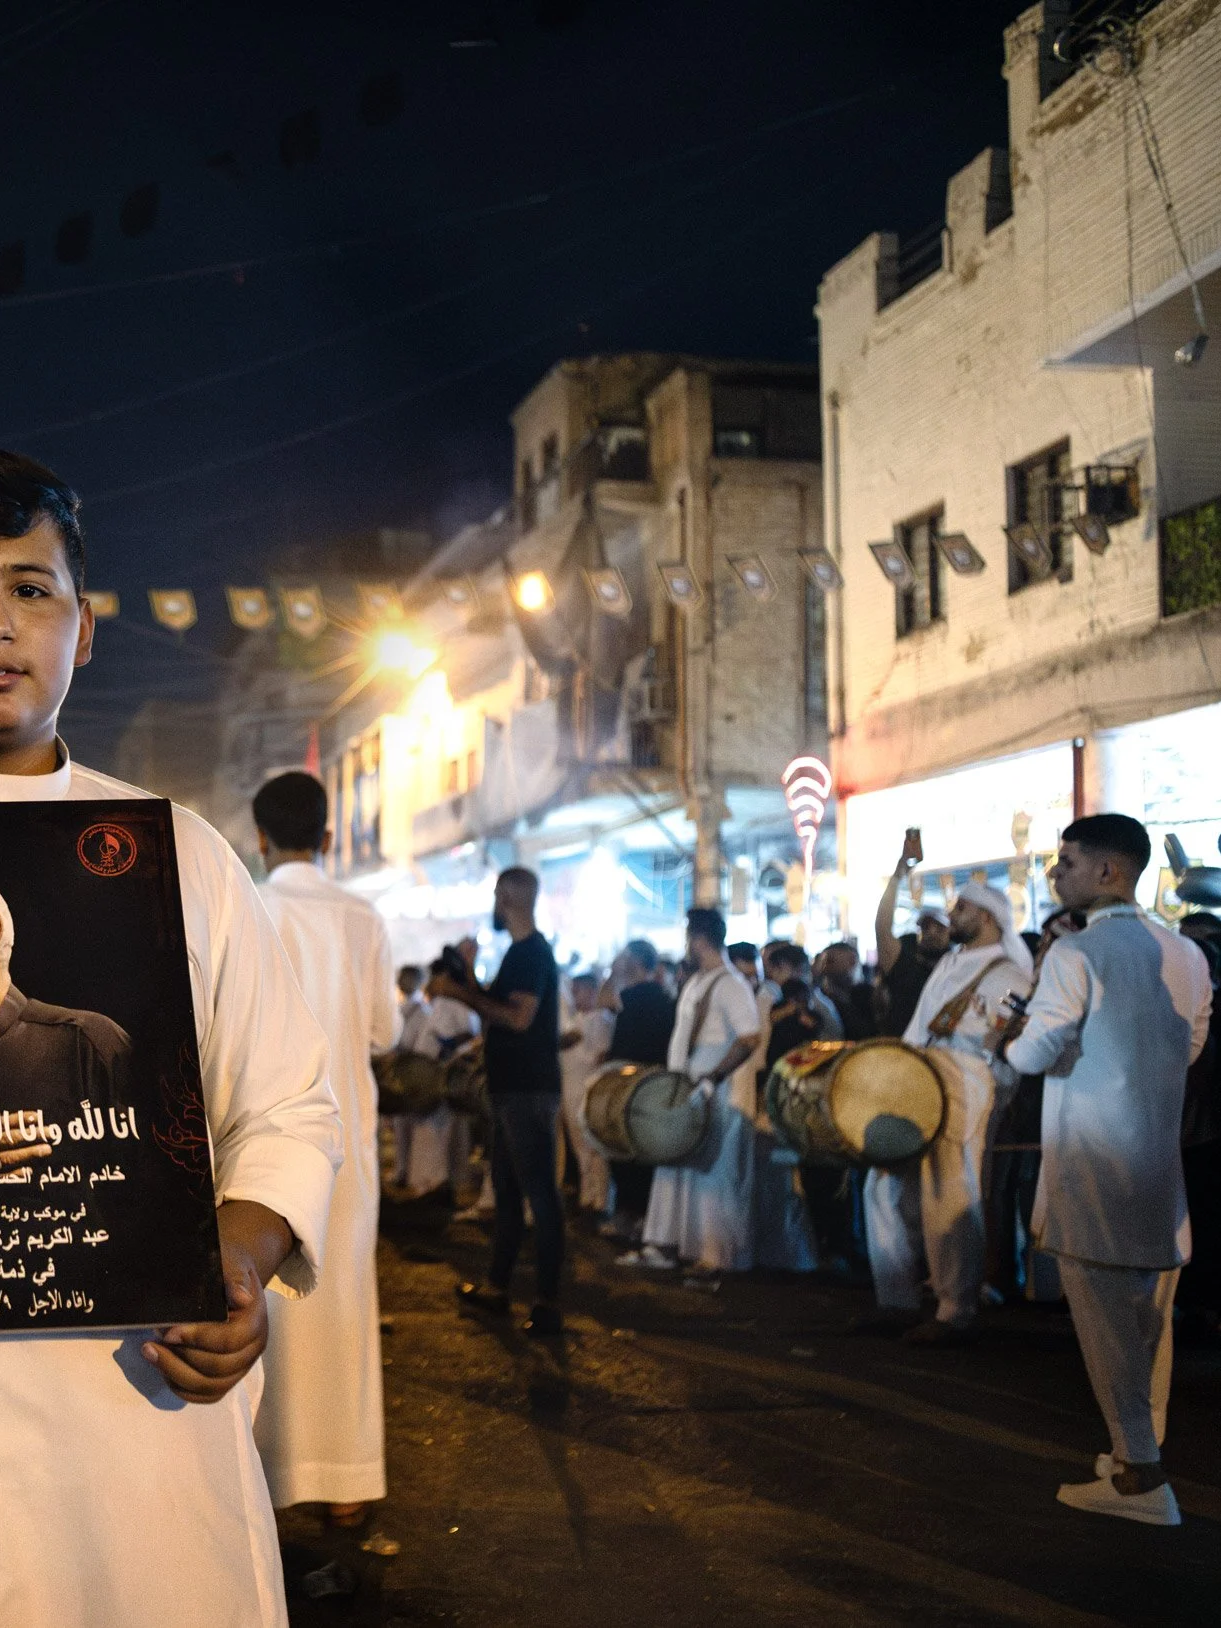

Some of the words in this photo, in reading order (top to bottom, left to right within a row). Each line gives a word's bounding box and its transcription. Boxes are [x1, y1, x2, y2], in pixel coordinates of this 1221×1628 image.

[17, 1109, 63, 1146] وانا
[109, 1106, 141, 1140] انا
[39, 1165, 81, 1191] الامام
[89, 1164, 126, 1189] خادم
[0, 1205, 30, 1222] ولاية
[33, 1206, 67, 1221] موكب
[70, 1202, 87, 1222] في
[27, 1226, 73, 1252] الكريم
[82, 1227, 110, 1248] عبد
[32, 1257, 56, 1286] في
[28, 1288, 63, 1317] الاجل
[66, 1290, 94, 1313] وافاه
